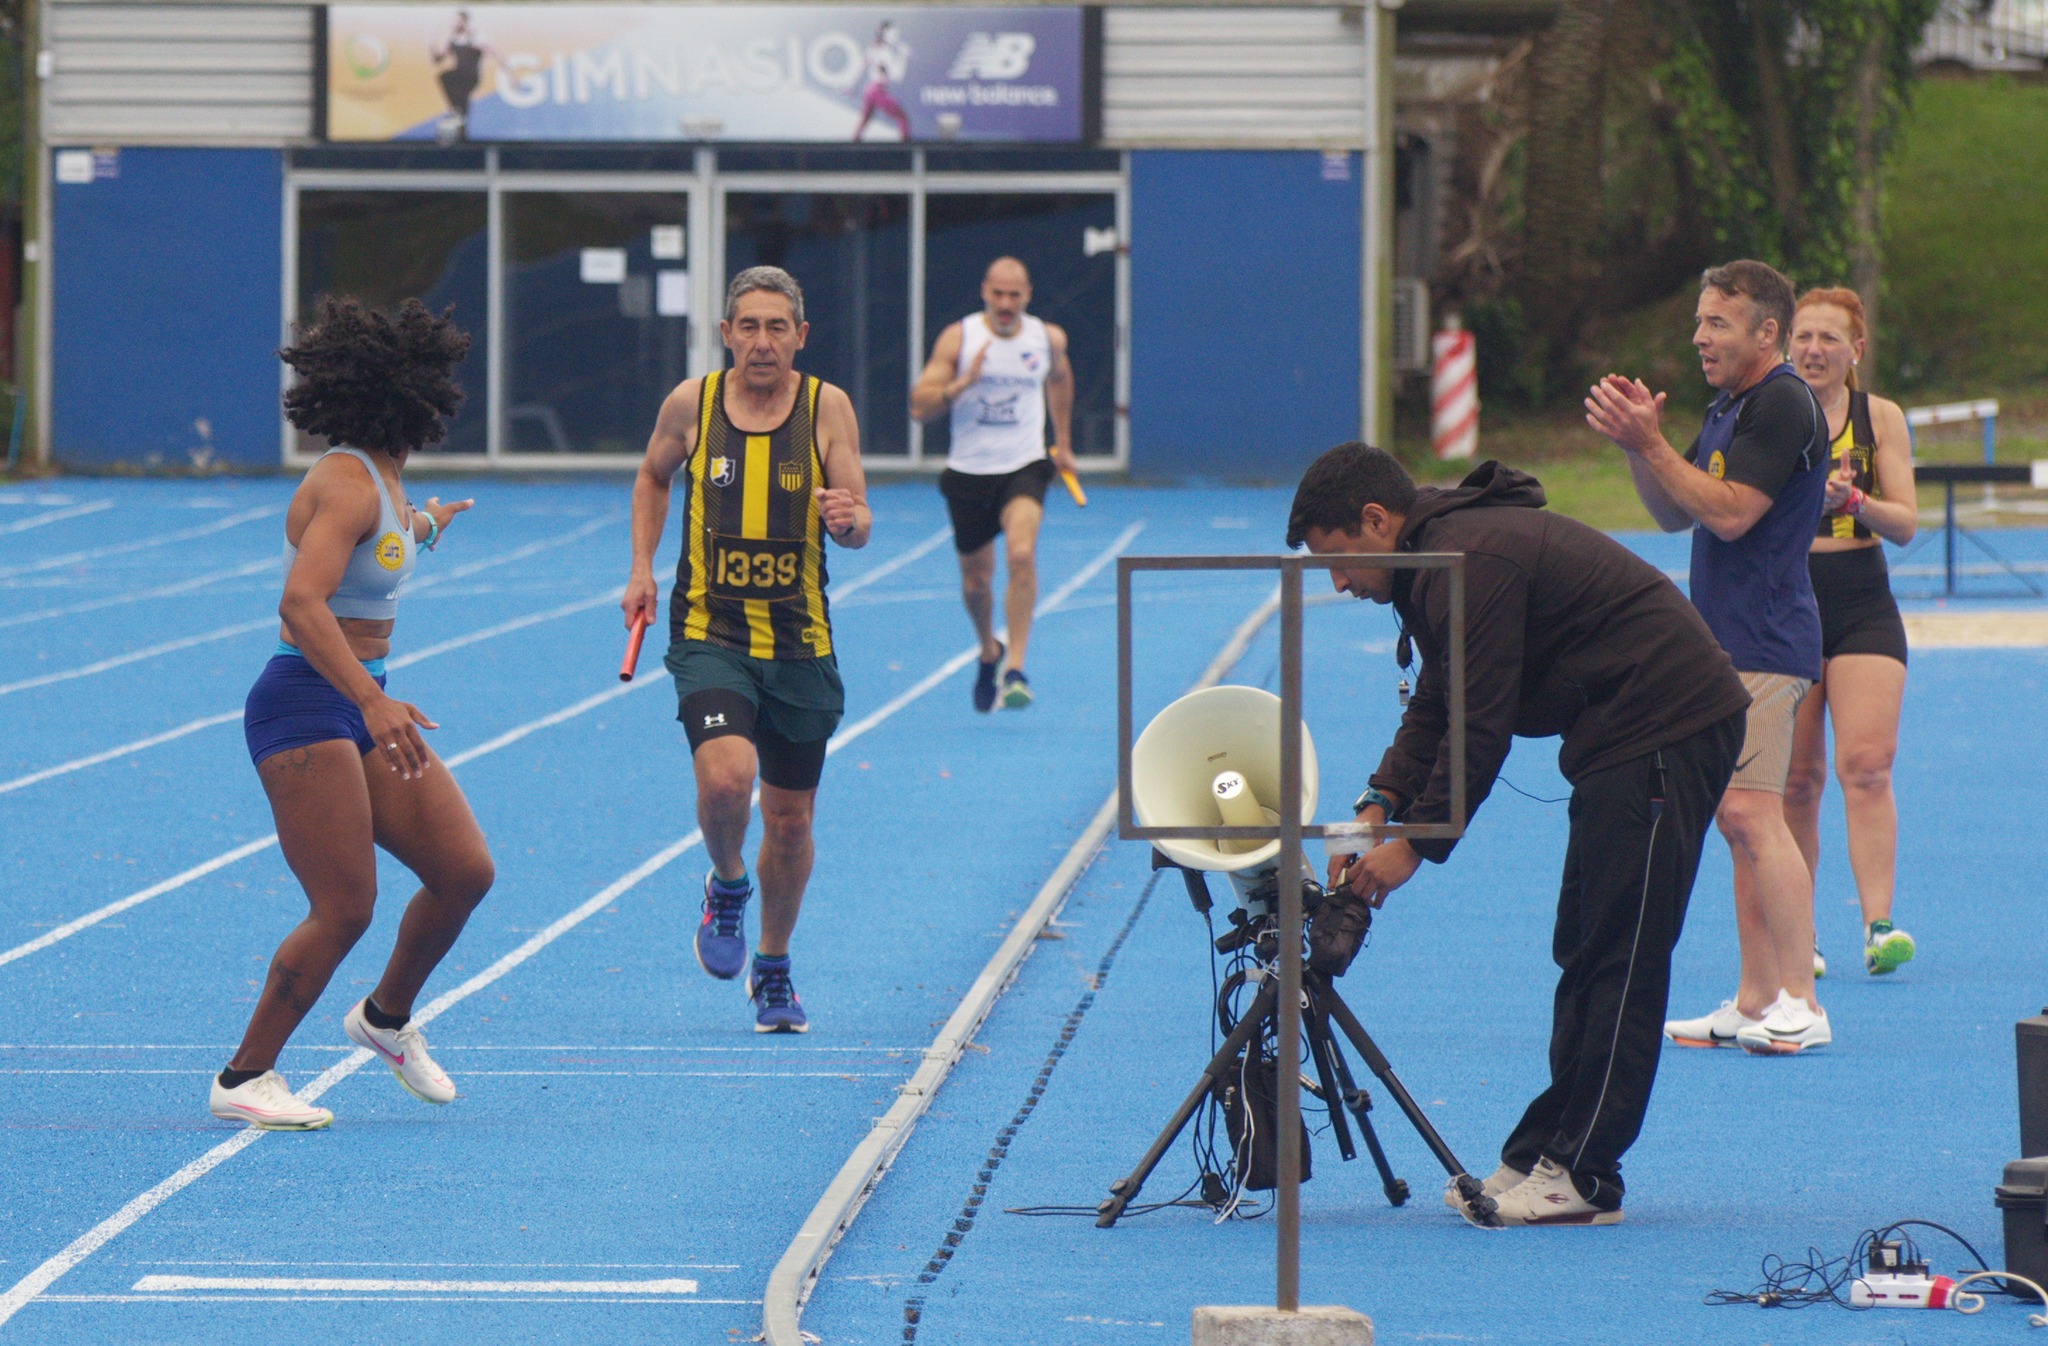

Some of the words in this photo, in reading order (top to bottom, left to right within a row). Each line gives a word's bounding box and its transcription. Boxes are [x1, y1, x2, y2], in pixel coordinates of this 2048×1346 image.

[495, 32, 861, 109] GIMNASIO
[920, 84, 967, 106] new
[969, 82, 1059, 106] balance
[716, 547, 797, 588] 1339
